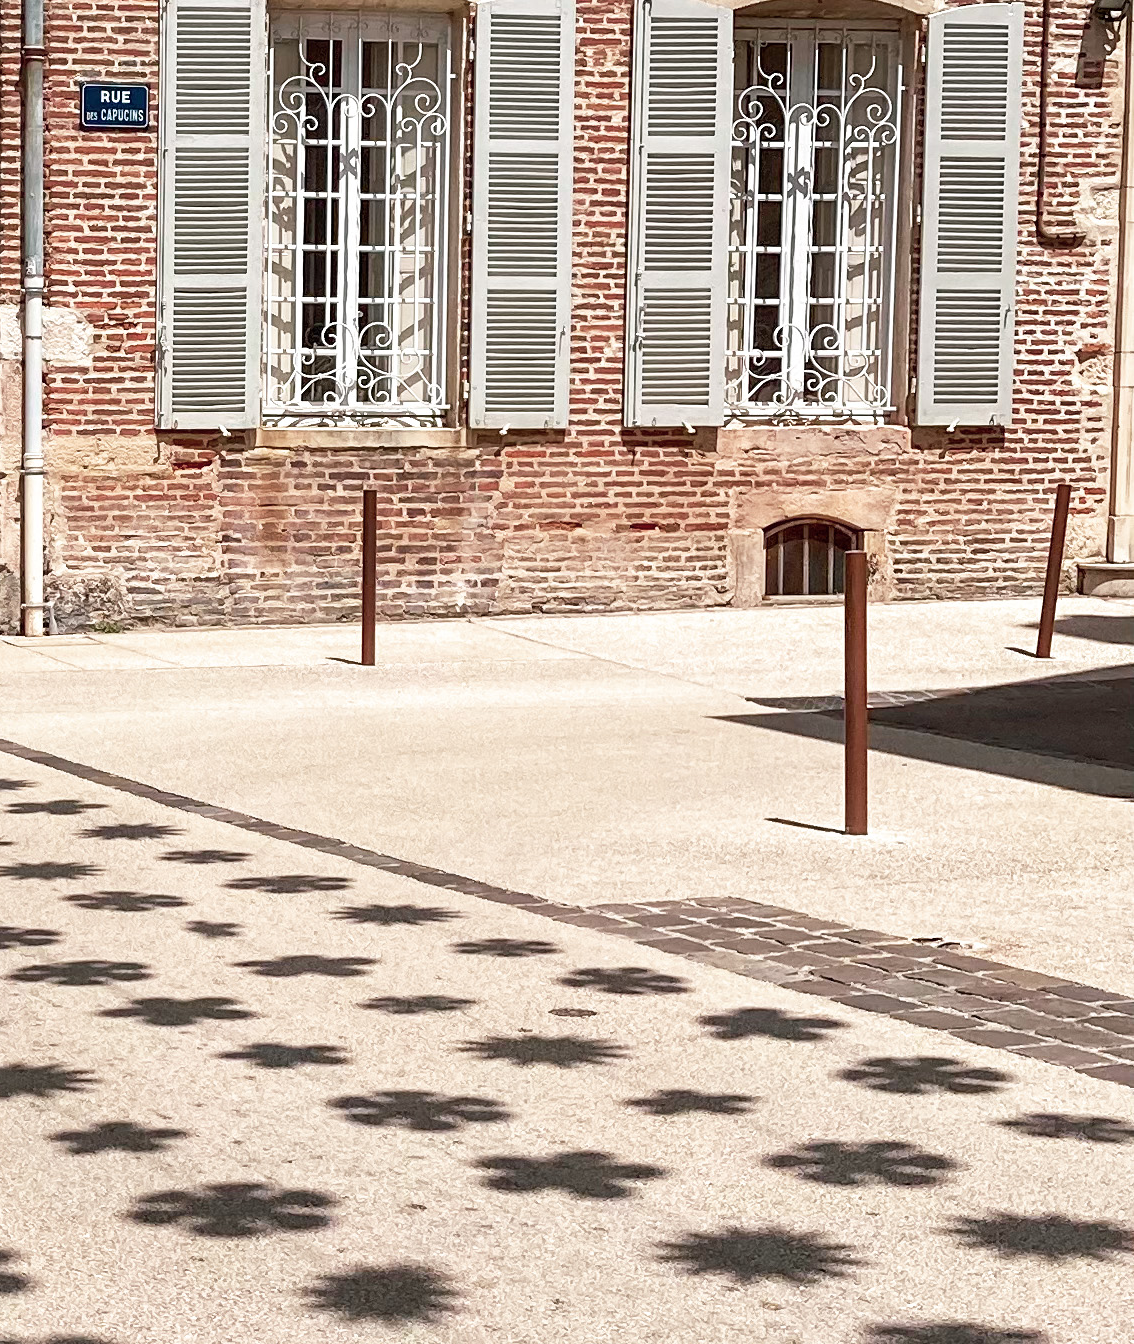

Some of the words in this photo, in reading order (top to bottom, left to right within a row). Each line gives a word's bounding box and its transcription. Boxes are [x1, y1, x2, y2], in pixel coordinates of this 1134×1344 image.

[100, 90, 131, 104] RUE
[86, 111, 98, 121] DES
[101, 108, 144, 122] CAPUCINS
